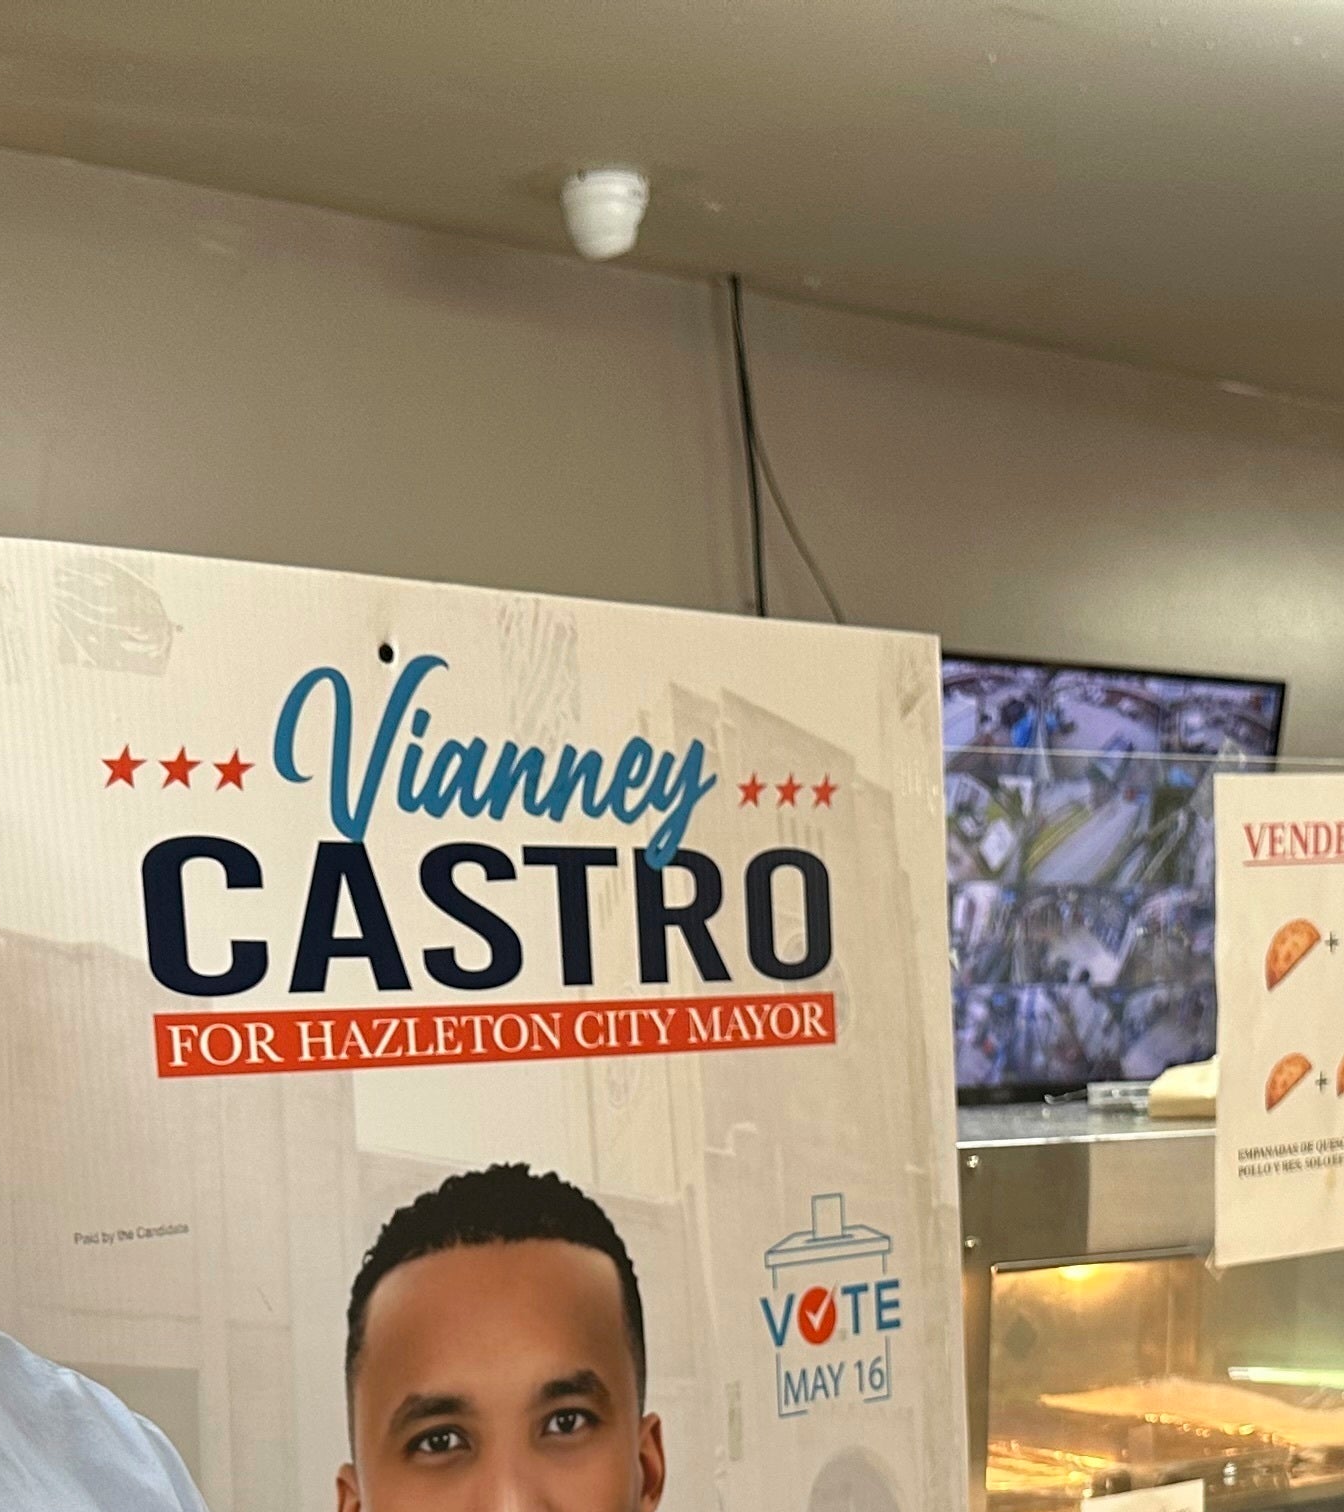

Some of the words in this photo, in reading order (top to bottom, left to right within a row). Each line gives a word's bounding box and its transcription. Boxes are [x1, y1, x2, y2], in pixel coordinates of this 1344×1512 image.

[272, 655, 717, 869] Vianney
[142, 836, 834, 996] CASTRO
[167, 1024, 284, 1068] FOR
[297, 1013, 562, 1063] HAZLETON
[573, 1008, 676, 1049] CITY
[686, 1002, 829, 1046] MAYOR
[759, 1278, 902, 1348] VOTE
[784, 1361, 846, 1407] MAY
[854, 1355, 886, 1394] 16
